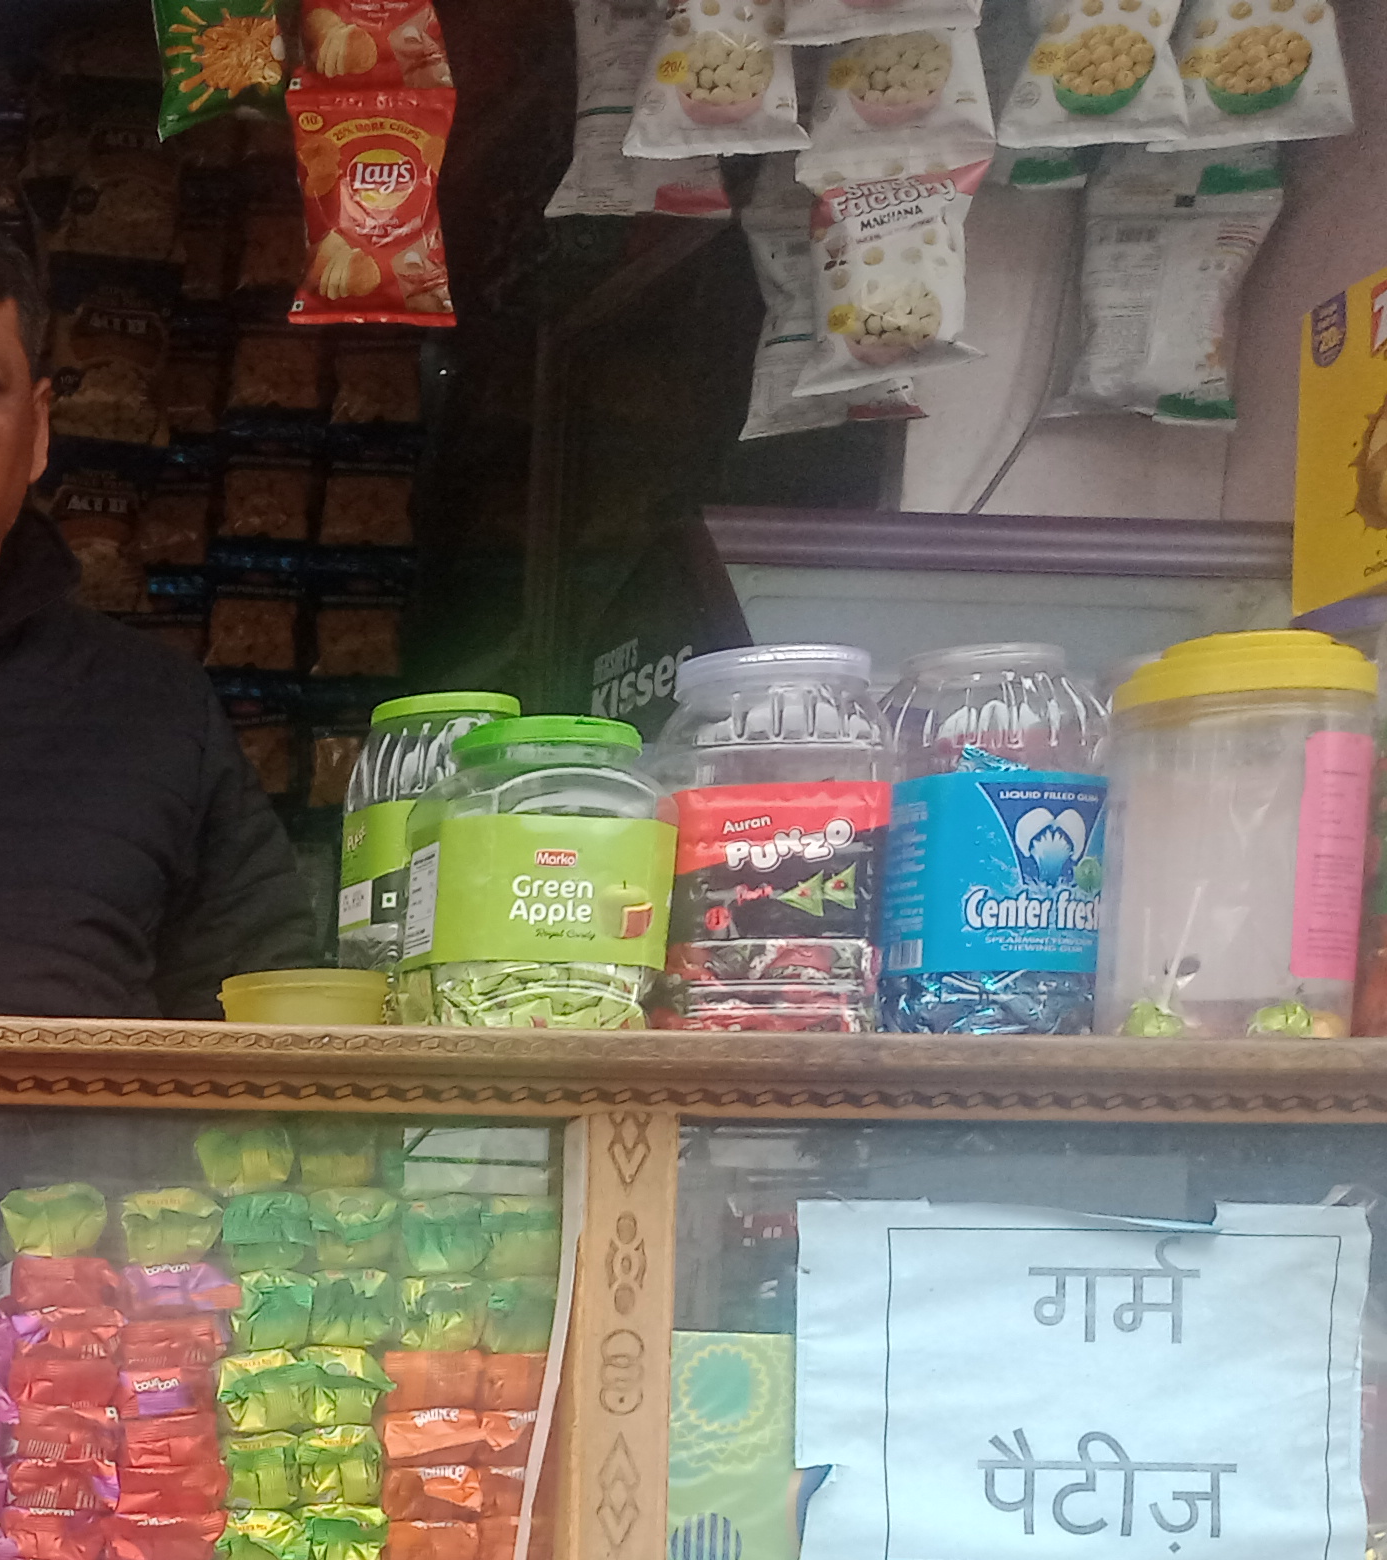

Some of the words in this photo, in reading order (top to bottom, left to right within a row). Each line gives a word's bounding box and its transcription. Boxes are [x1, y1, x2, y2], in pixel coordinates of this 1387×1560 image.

[354, 121, 386, 134] MORE
[389, 121, 425, 141] CHIPS
[353, 160, 412, 194] Lay's
[999, 790, 1041, 800] LIQUID
[1043, 790, 1076, 801] FILLED
[722, 815, 772, 835] Auran
[725, 816, 855, 872] PUNZO
[536, 852, 576, 866] Marko
[512, 874, 594, 899] Green
[509, 898, 593, 926] Apple
[964, 888, 1052, 931] Center
[1028, 1236, 1201, 1344] गर्म
[134, 1378, 180, 1392] bourbon
[977, 1427, 1237, 1553] पैटीज़
